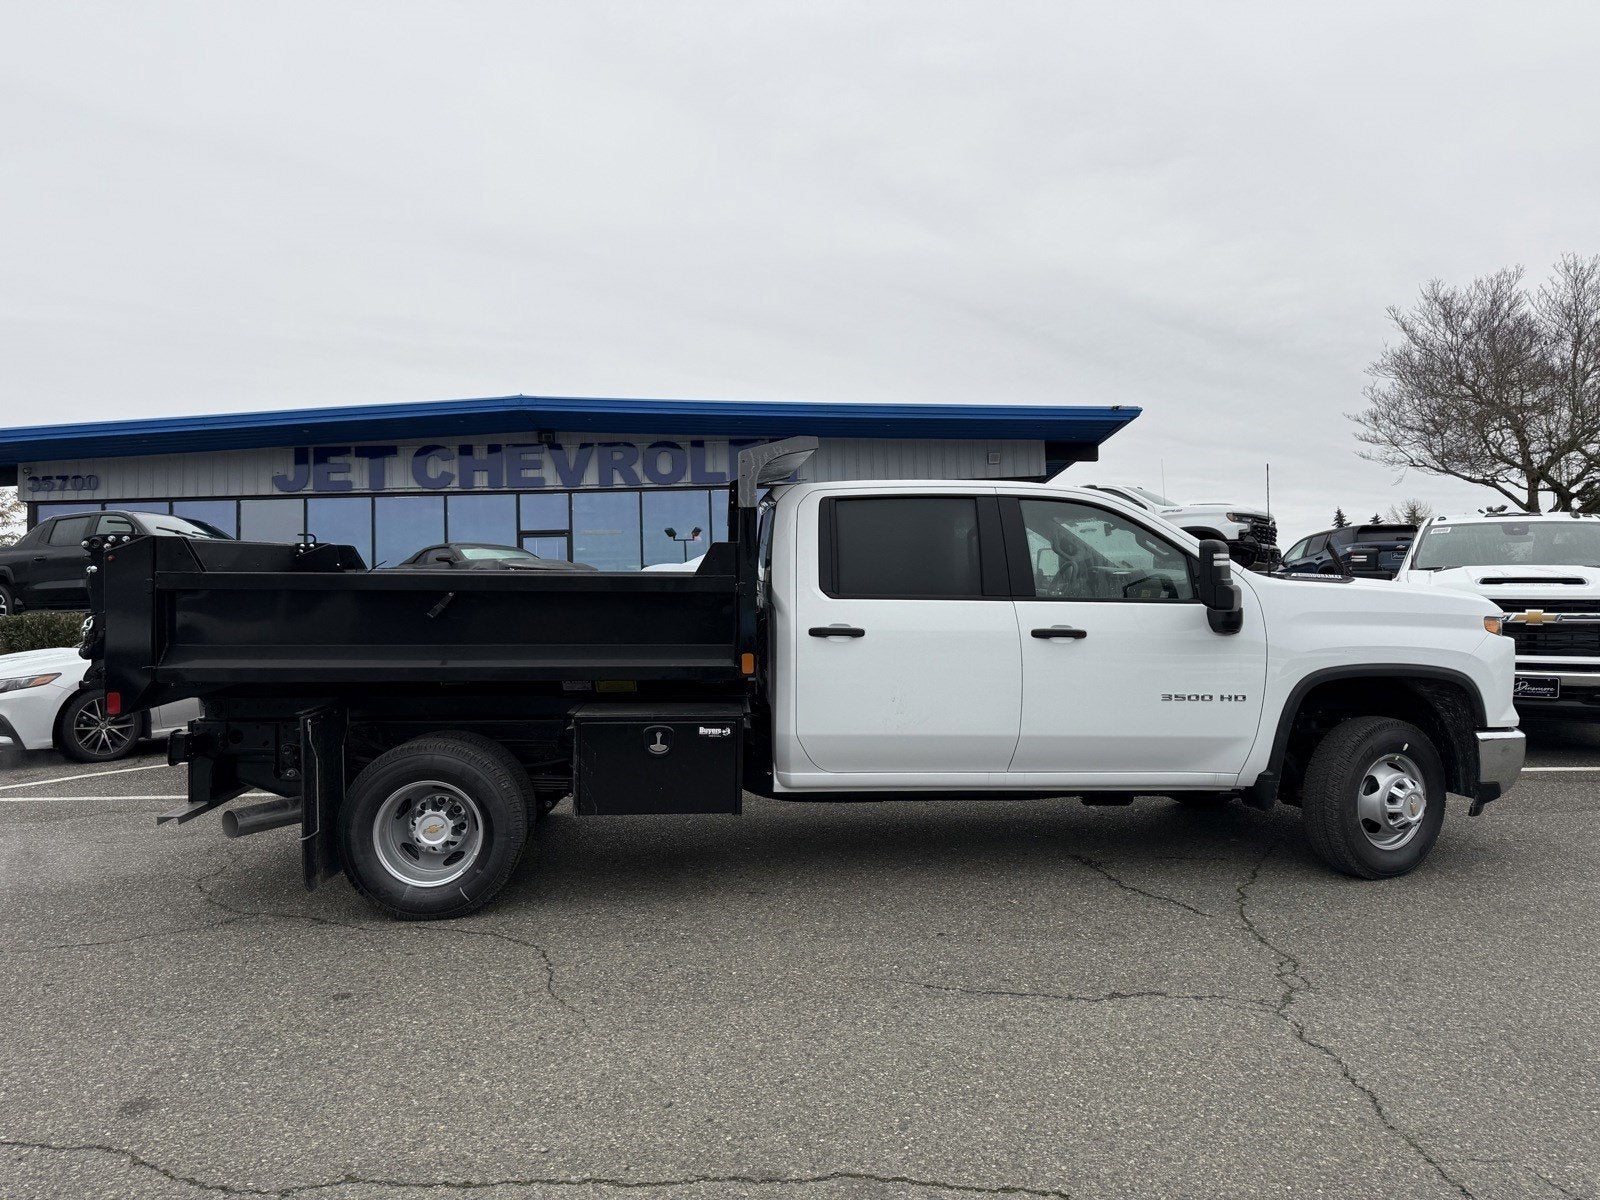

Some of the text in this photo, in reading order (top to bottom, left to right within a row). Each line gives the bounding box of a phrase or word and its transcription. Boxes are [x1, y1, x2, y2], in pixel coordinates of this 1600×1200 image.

[272, 438, 797, 492] JET CHEVROL
[27, 475, 99, 492] 35700
[1161, 693, 1247, 702] 3500 HD
[699, 726, 722, 735] Buyers
